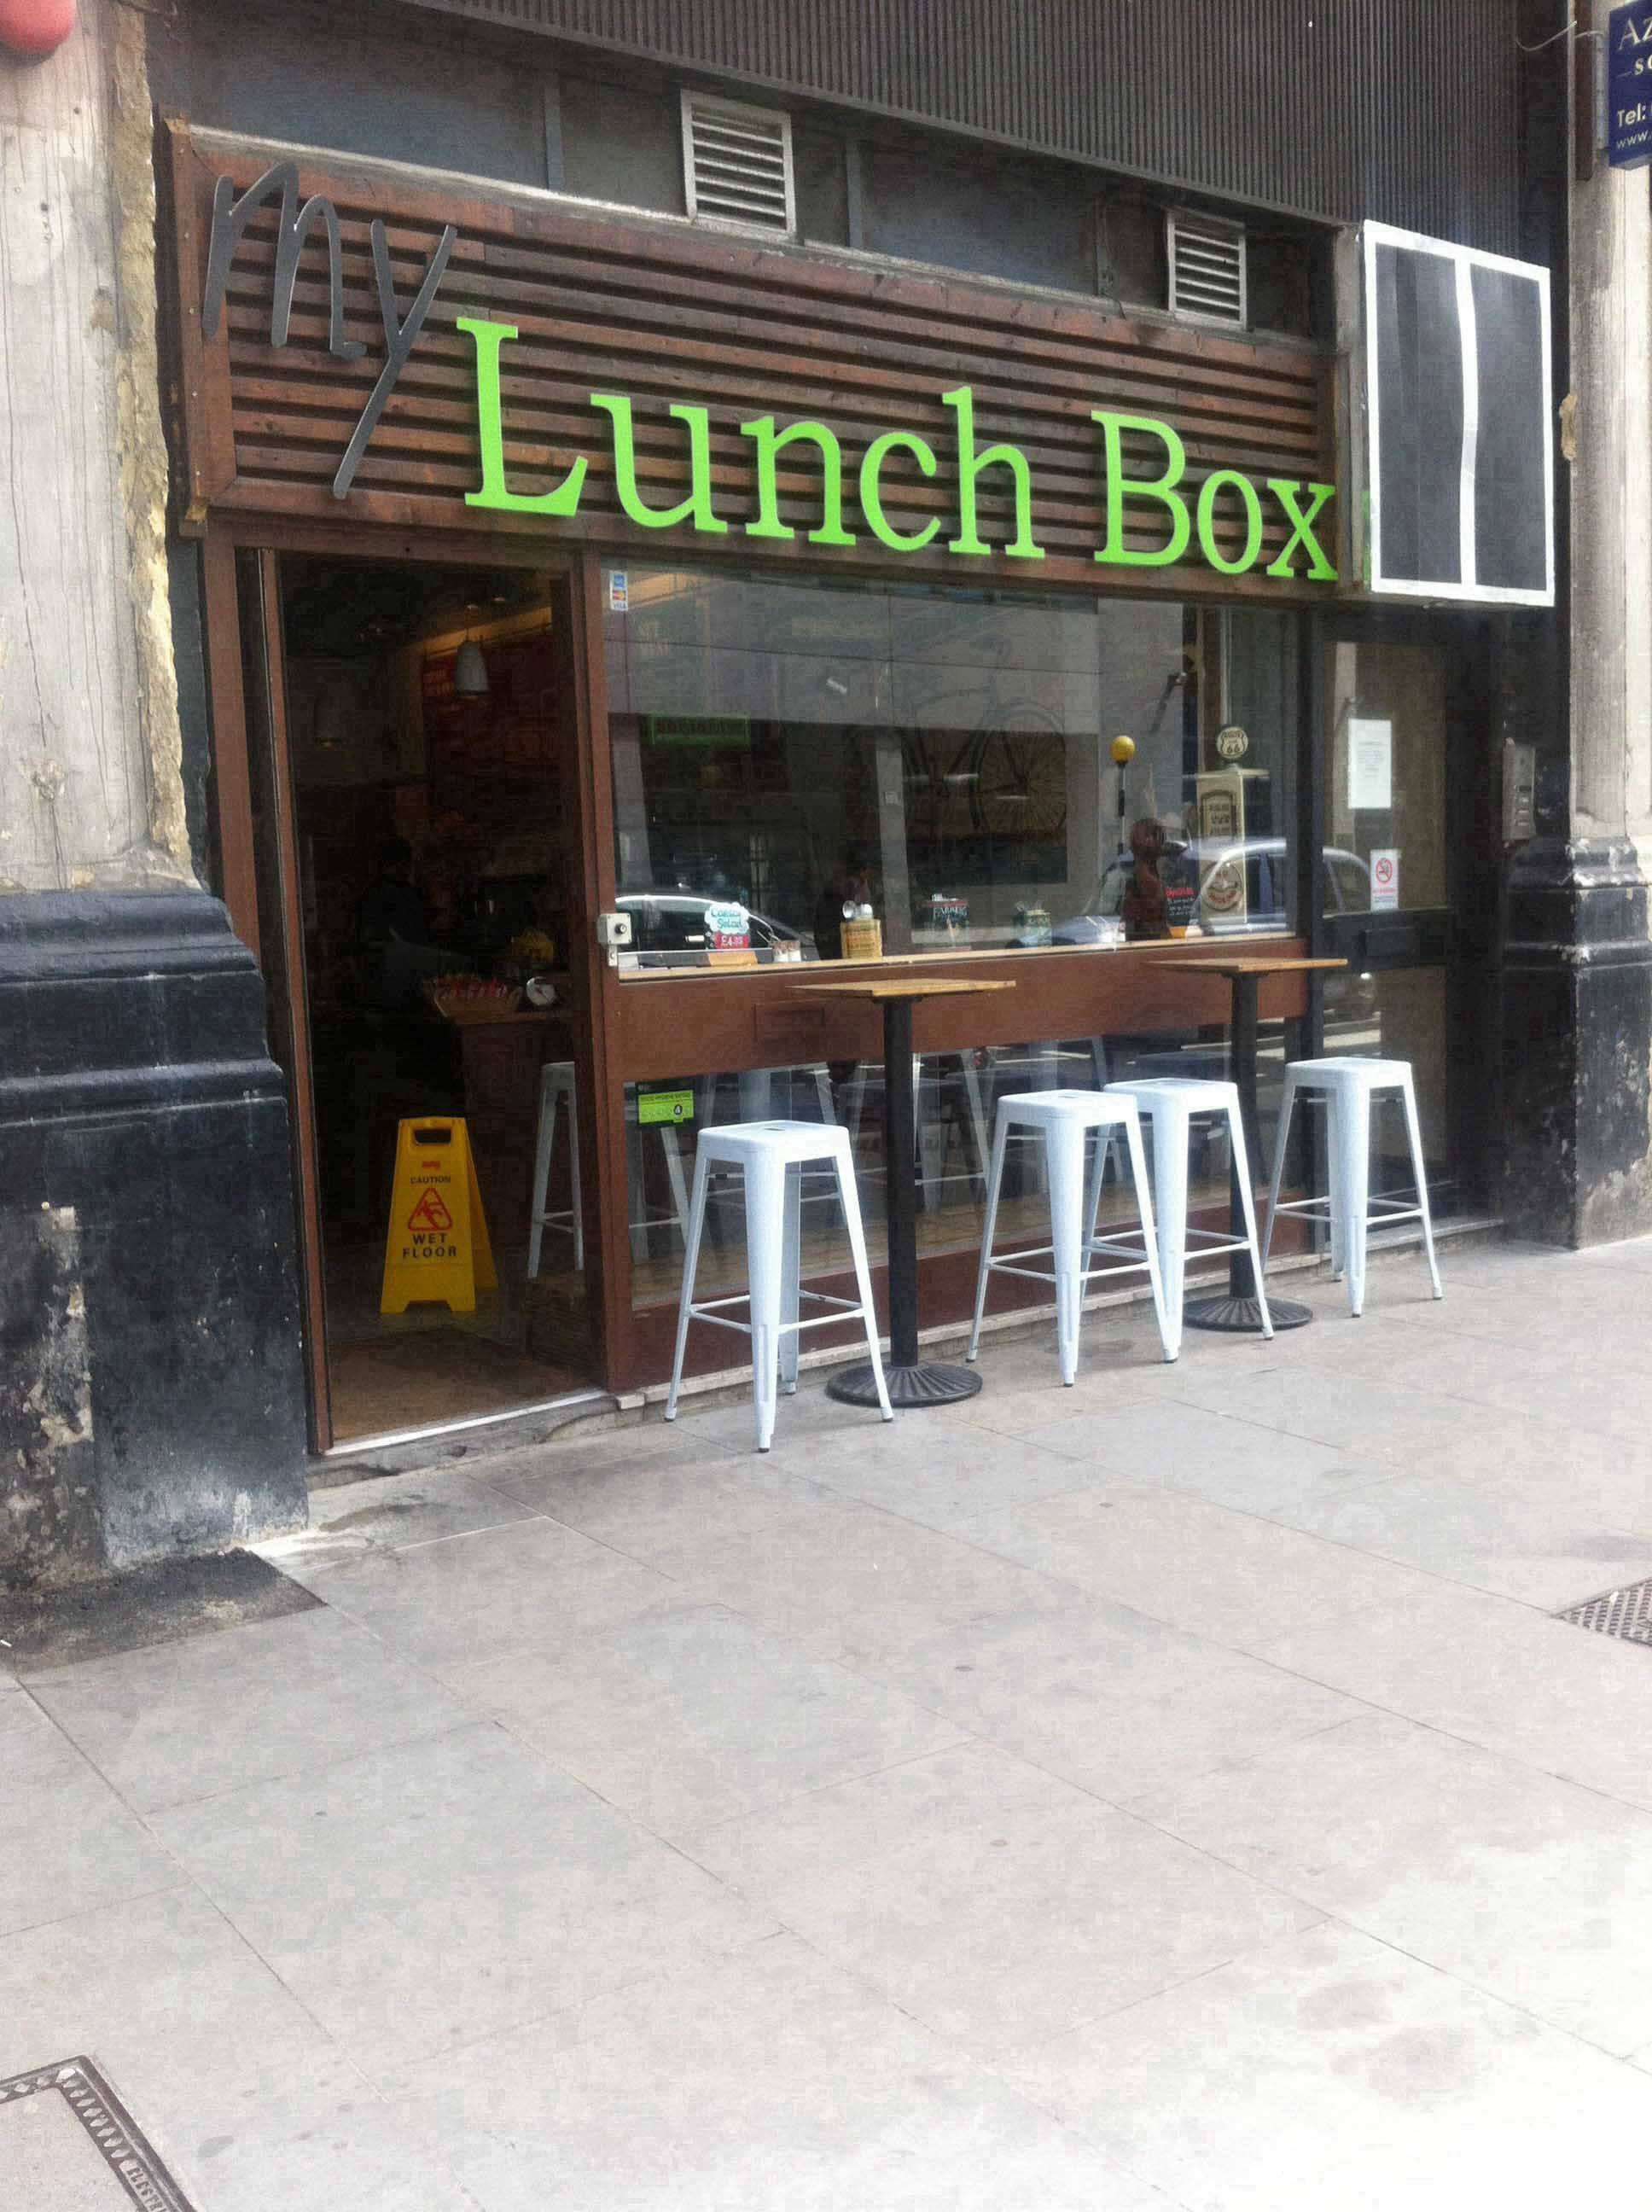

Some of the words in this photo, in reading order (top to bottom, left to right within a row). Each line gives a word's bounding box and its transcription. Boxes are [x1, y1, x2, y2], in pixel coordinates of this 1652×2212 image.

[456, 316, 1044, 559] Lunch
[1091, 410, 1338, 580] Box
[410, 1174, 451, 1185] CAUTION
[412, 1232, 448, 1245] WET
[402, 1246, 457, 1260] FLOOR
